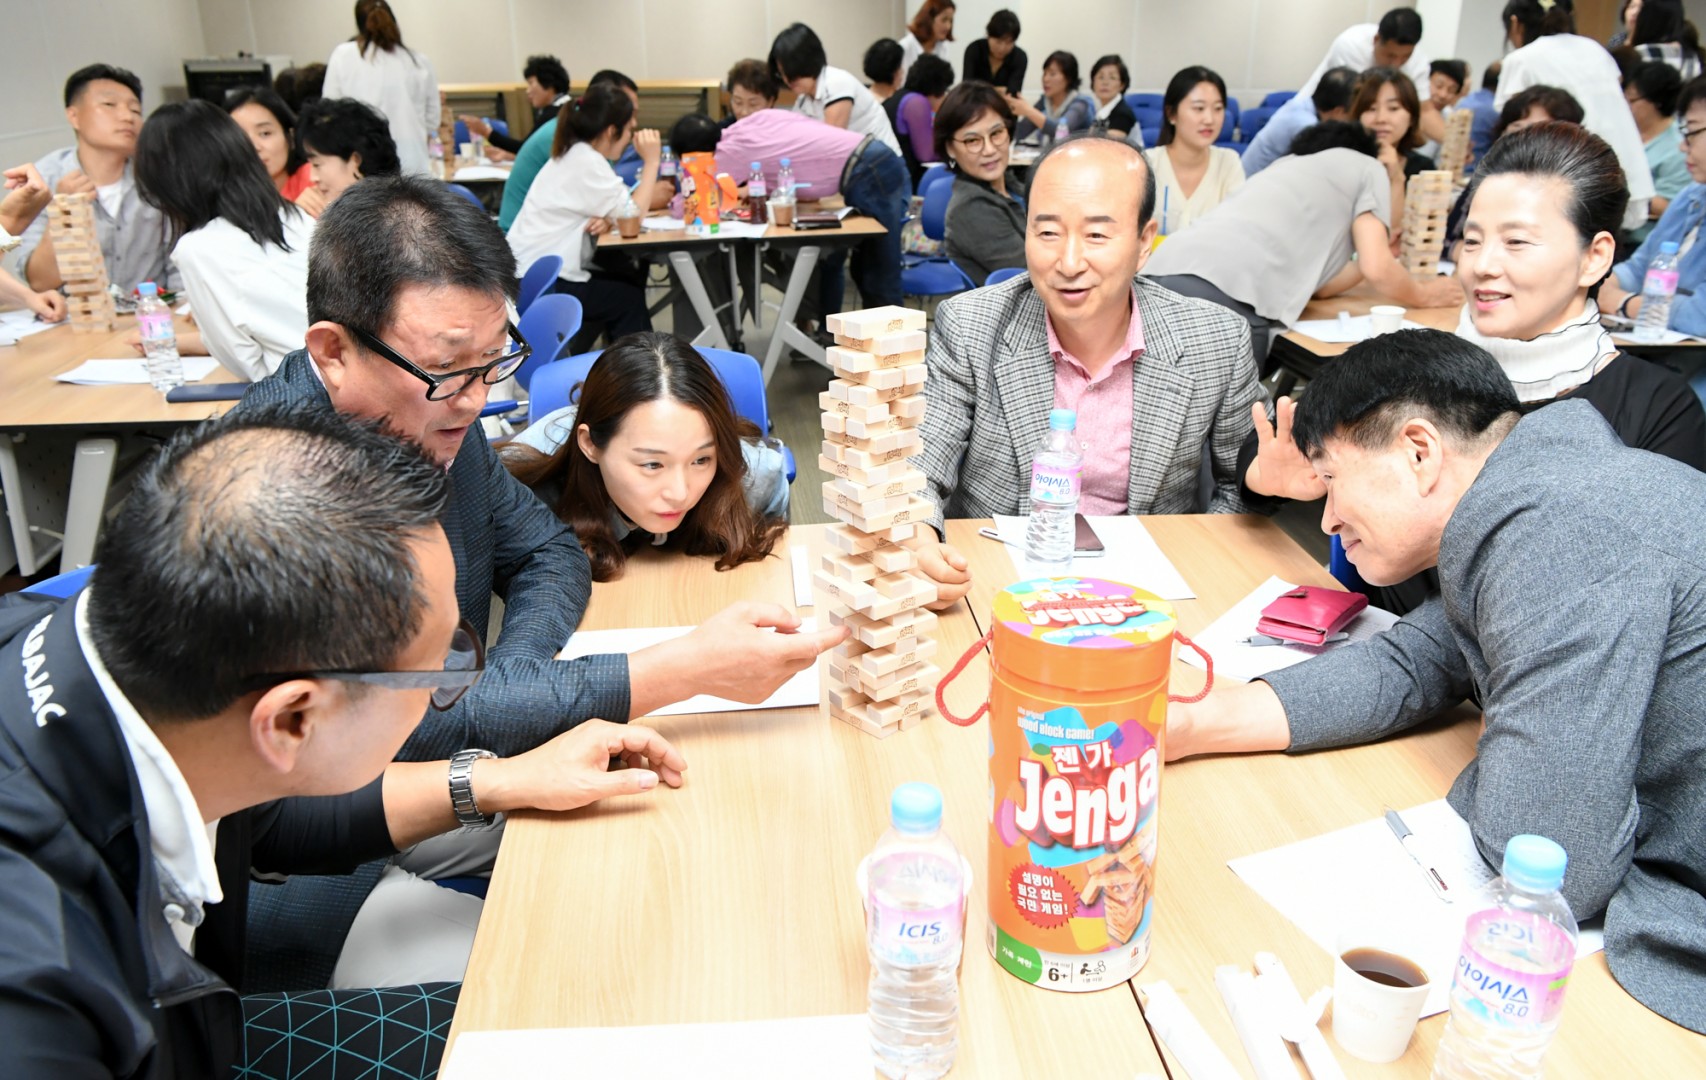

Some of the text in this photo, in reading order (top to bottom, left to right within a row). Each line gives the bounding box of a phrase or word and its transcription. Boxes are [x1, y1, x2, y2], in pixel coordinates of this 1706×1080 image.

[1035, 473, 1070, 487] 아이시스
[1014, 746, 1159, 848] Jenga
[1021, 871, 1054, 888] 설명이
[1017, 882, 1063, 902] 필요 없는
[1017, 895, 1069, 915] 국민 게임!
[898, 921, 942, 938] ICIS
[1048, 967, 1069, 982] 6+
[1458, 954, 1530, 1004] 아이시스
[1502, 1003, 1530, 1018] 8.0
